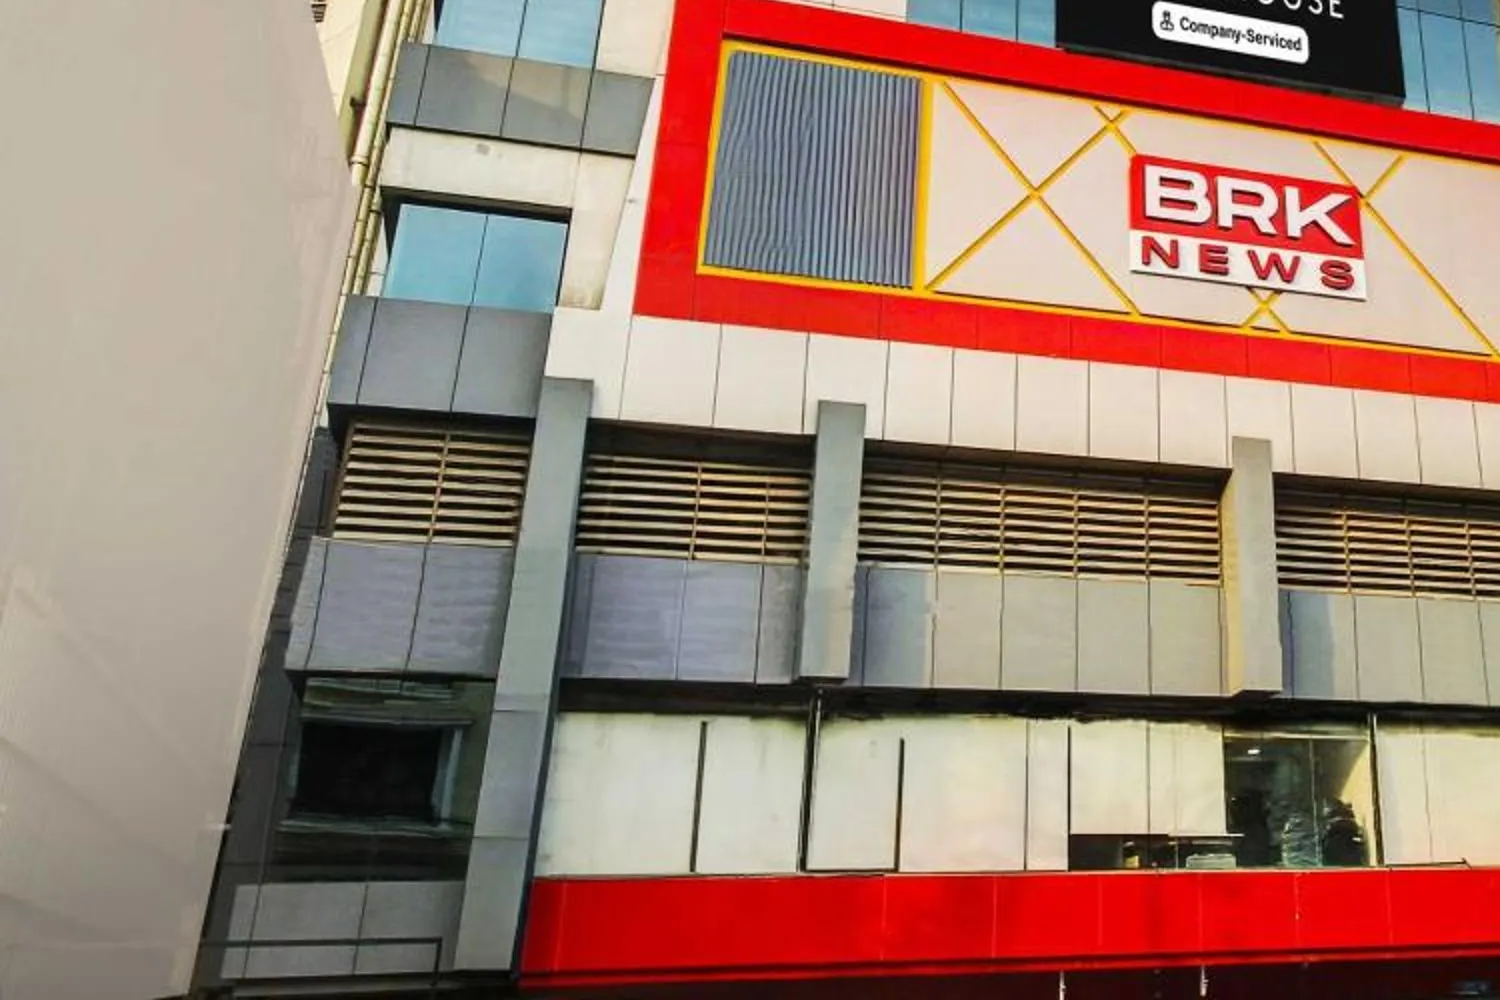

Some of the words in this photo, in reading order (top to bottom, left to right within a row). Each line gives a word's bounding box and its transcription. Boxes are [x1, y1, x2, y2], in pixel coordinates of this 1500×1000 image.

[1179, 15, 1303, 52] Company-Serviced
[1144, 163, 1357, 248] BRK
[1141, 235, 1355, 291] NEWS
